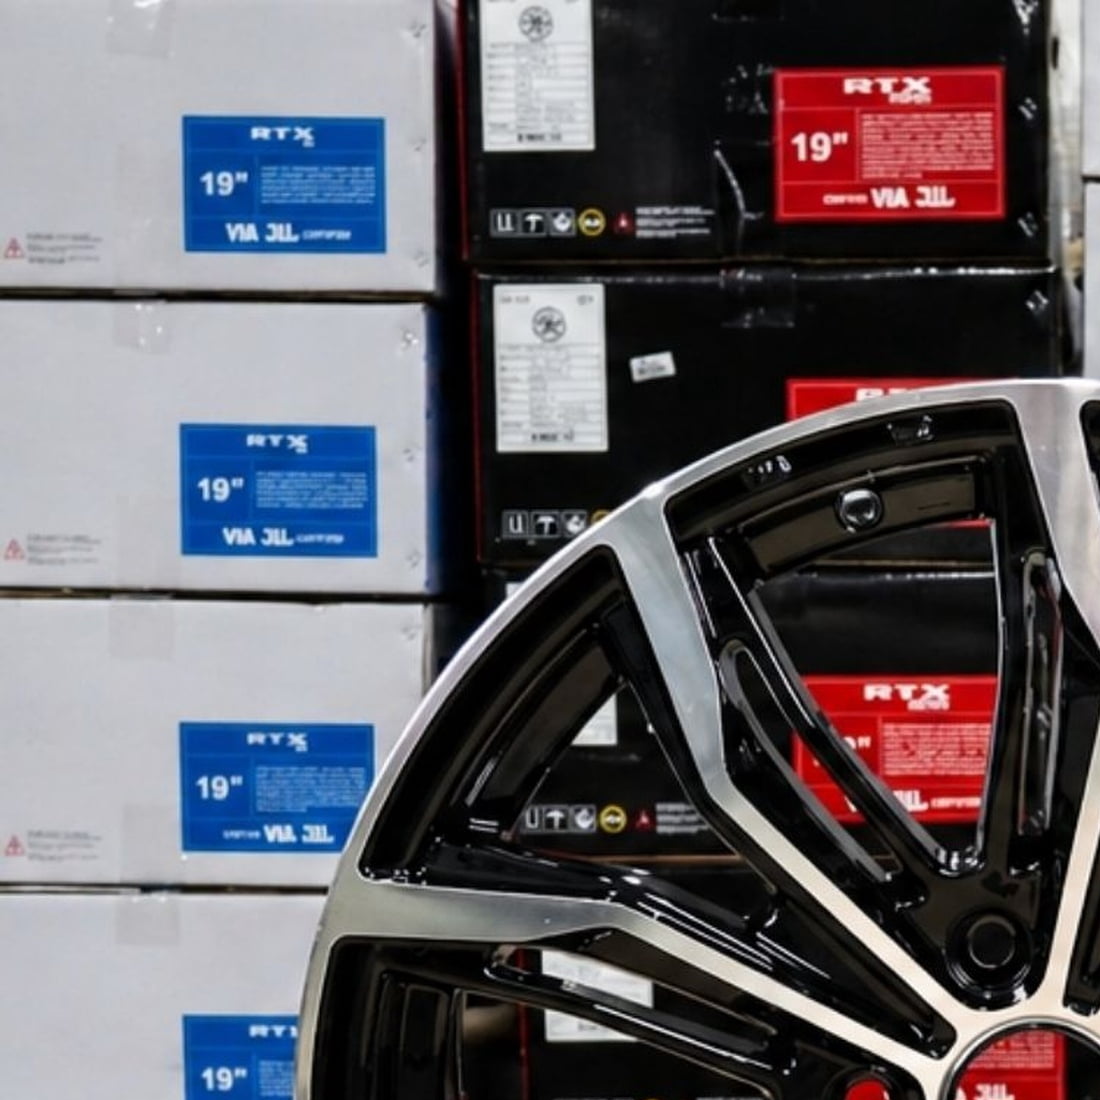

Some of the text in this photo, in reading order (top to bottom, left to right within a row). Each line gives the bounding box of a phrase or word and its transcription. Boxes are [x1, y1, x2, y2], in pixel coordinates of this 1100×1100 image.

[843, 76, 932, 95] RTX
[250, 126, 314, 142] RTX
[791, 131, 849, 162] 19"
[200, 171, 249, 196] 19"
[246, 434, 308, 448] RTX
[197, 477, 244, 502] 19"
[864, 683, 950, 702] RTX
[246, 732, 307, 746] RTX
[196, 775, 243, 801] 19"
[201, 1066, 248, 1091] 19"
